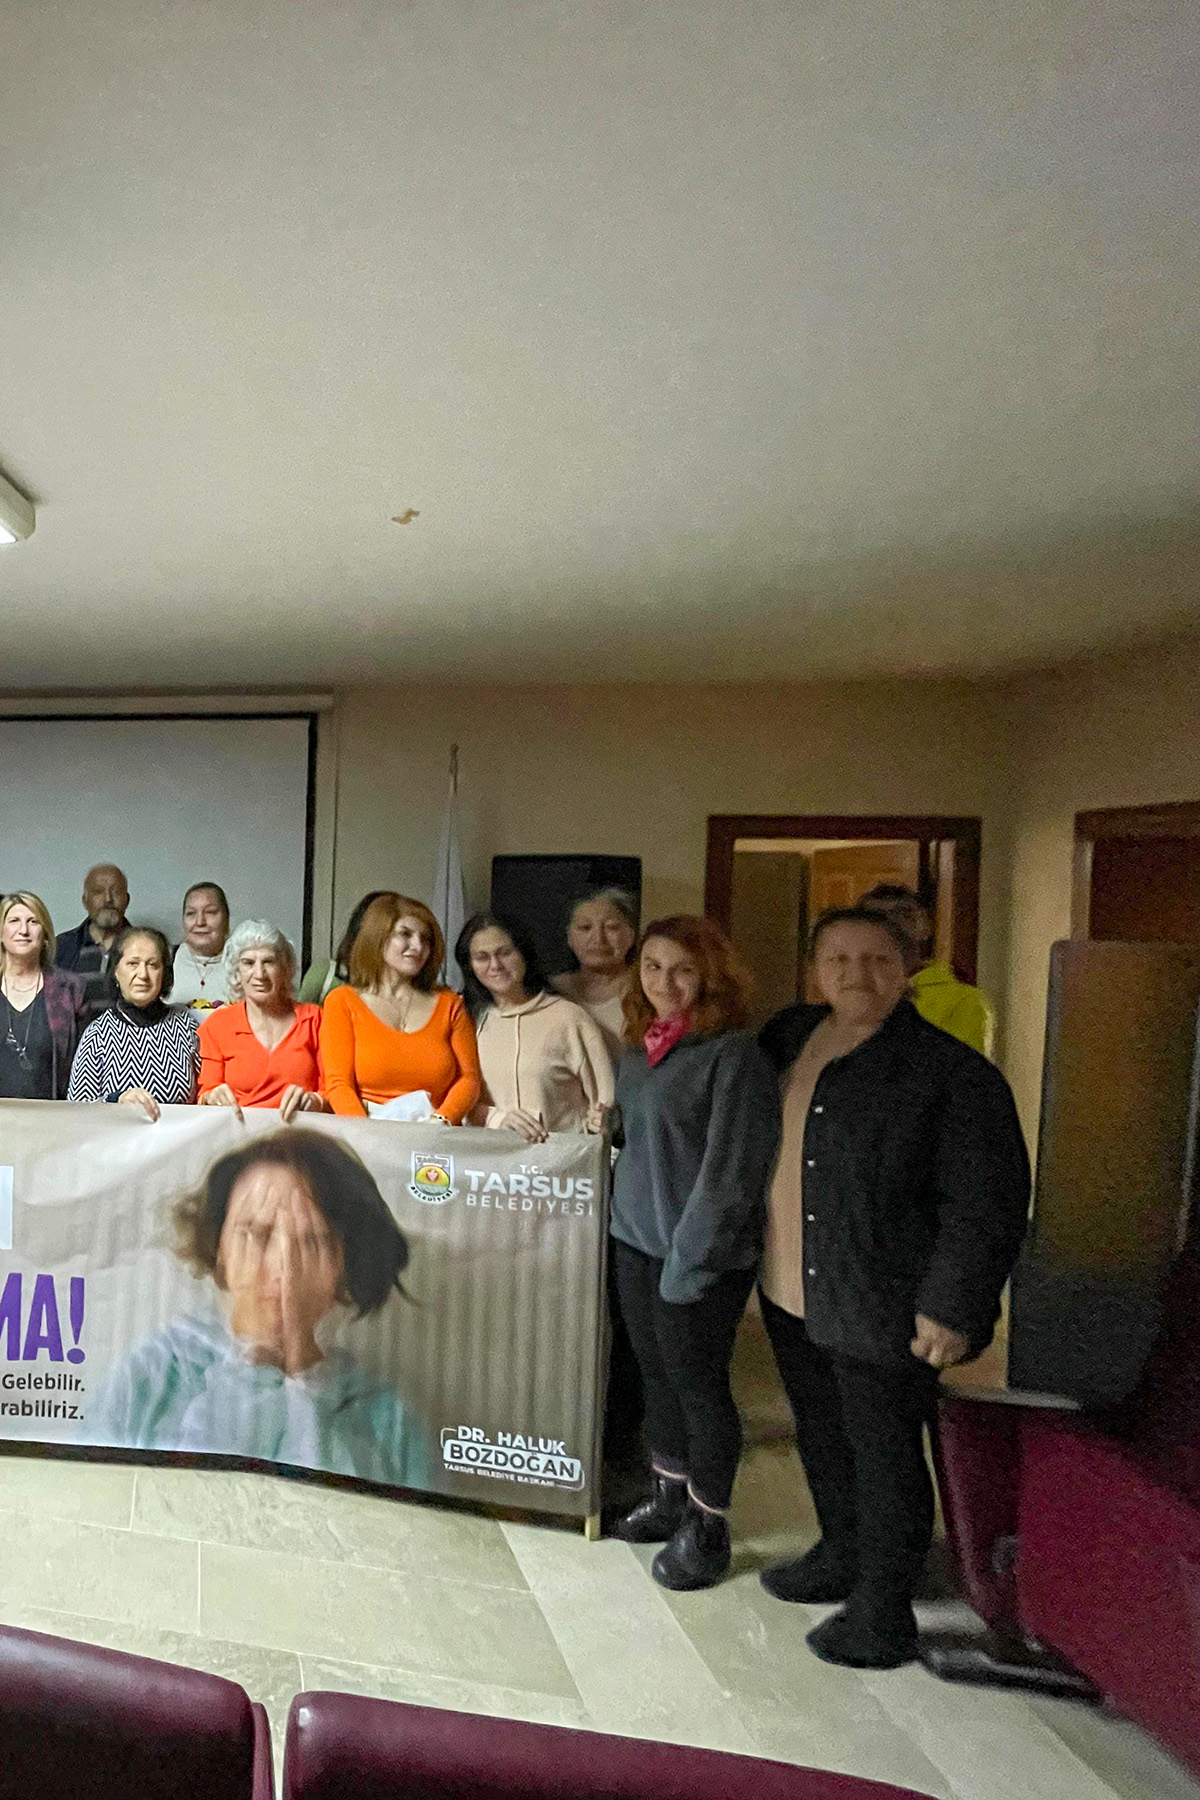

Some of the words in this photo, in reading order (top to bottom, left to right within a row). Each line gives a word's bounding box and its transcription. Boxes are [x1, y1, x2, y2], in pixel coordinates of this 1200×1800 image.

[464, 1169, 595, 1200] TARSUS
[519, 1164, 543, 1175] T.C.
[1, 1373, 86, 1392] Gelebilir.
[457, 1425, 491, 1443] DR.
[497, 1431, 567, 1456] HALUK
[450, 1443, 575, 1479] BOZDOĞAN
